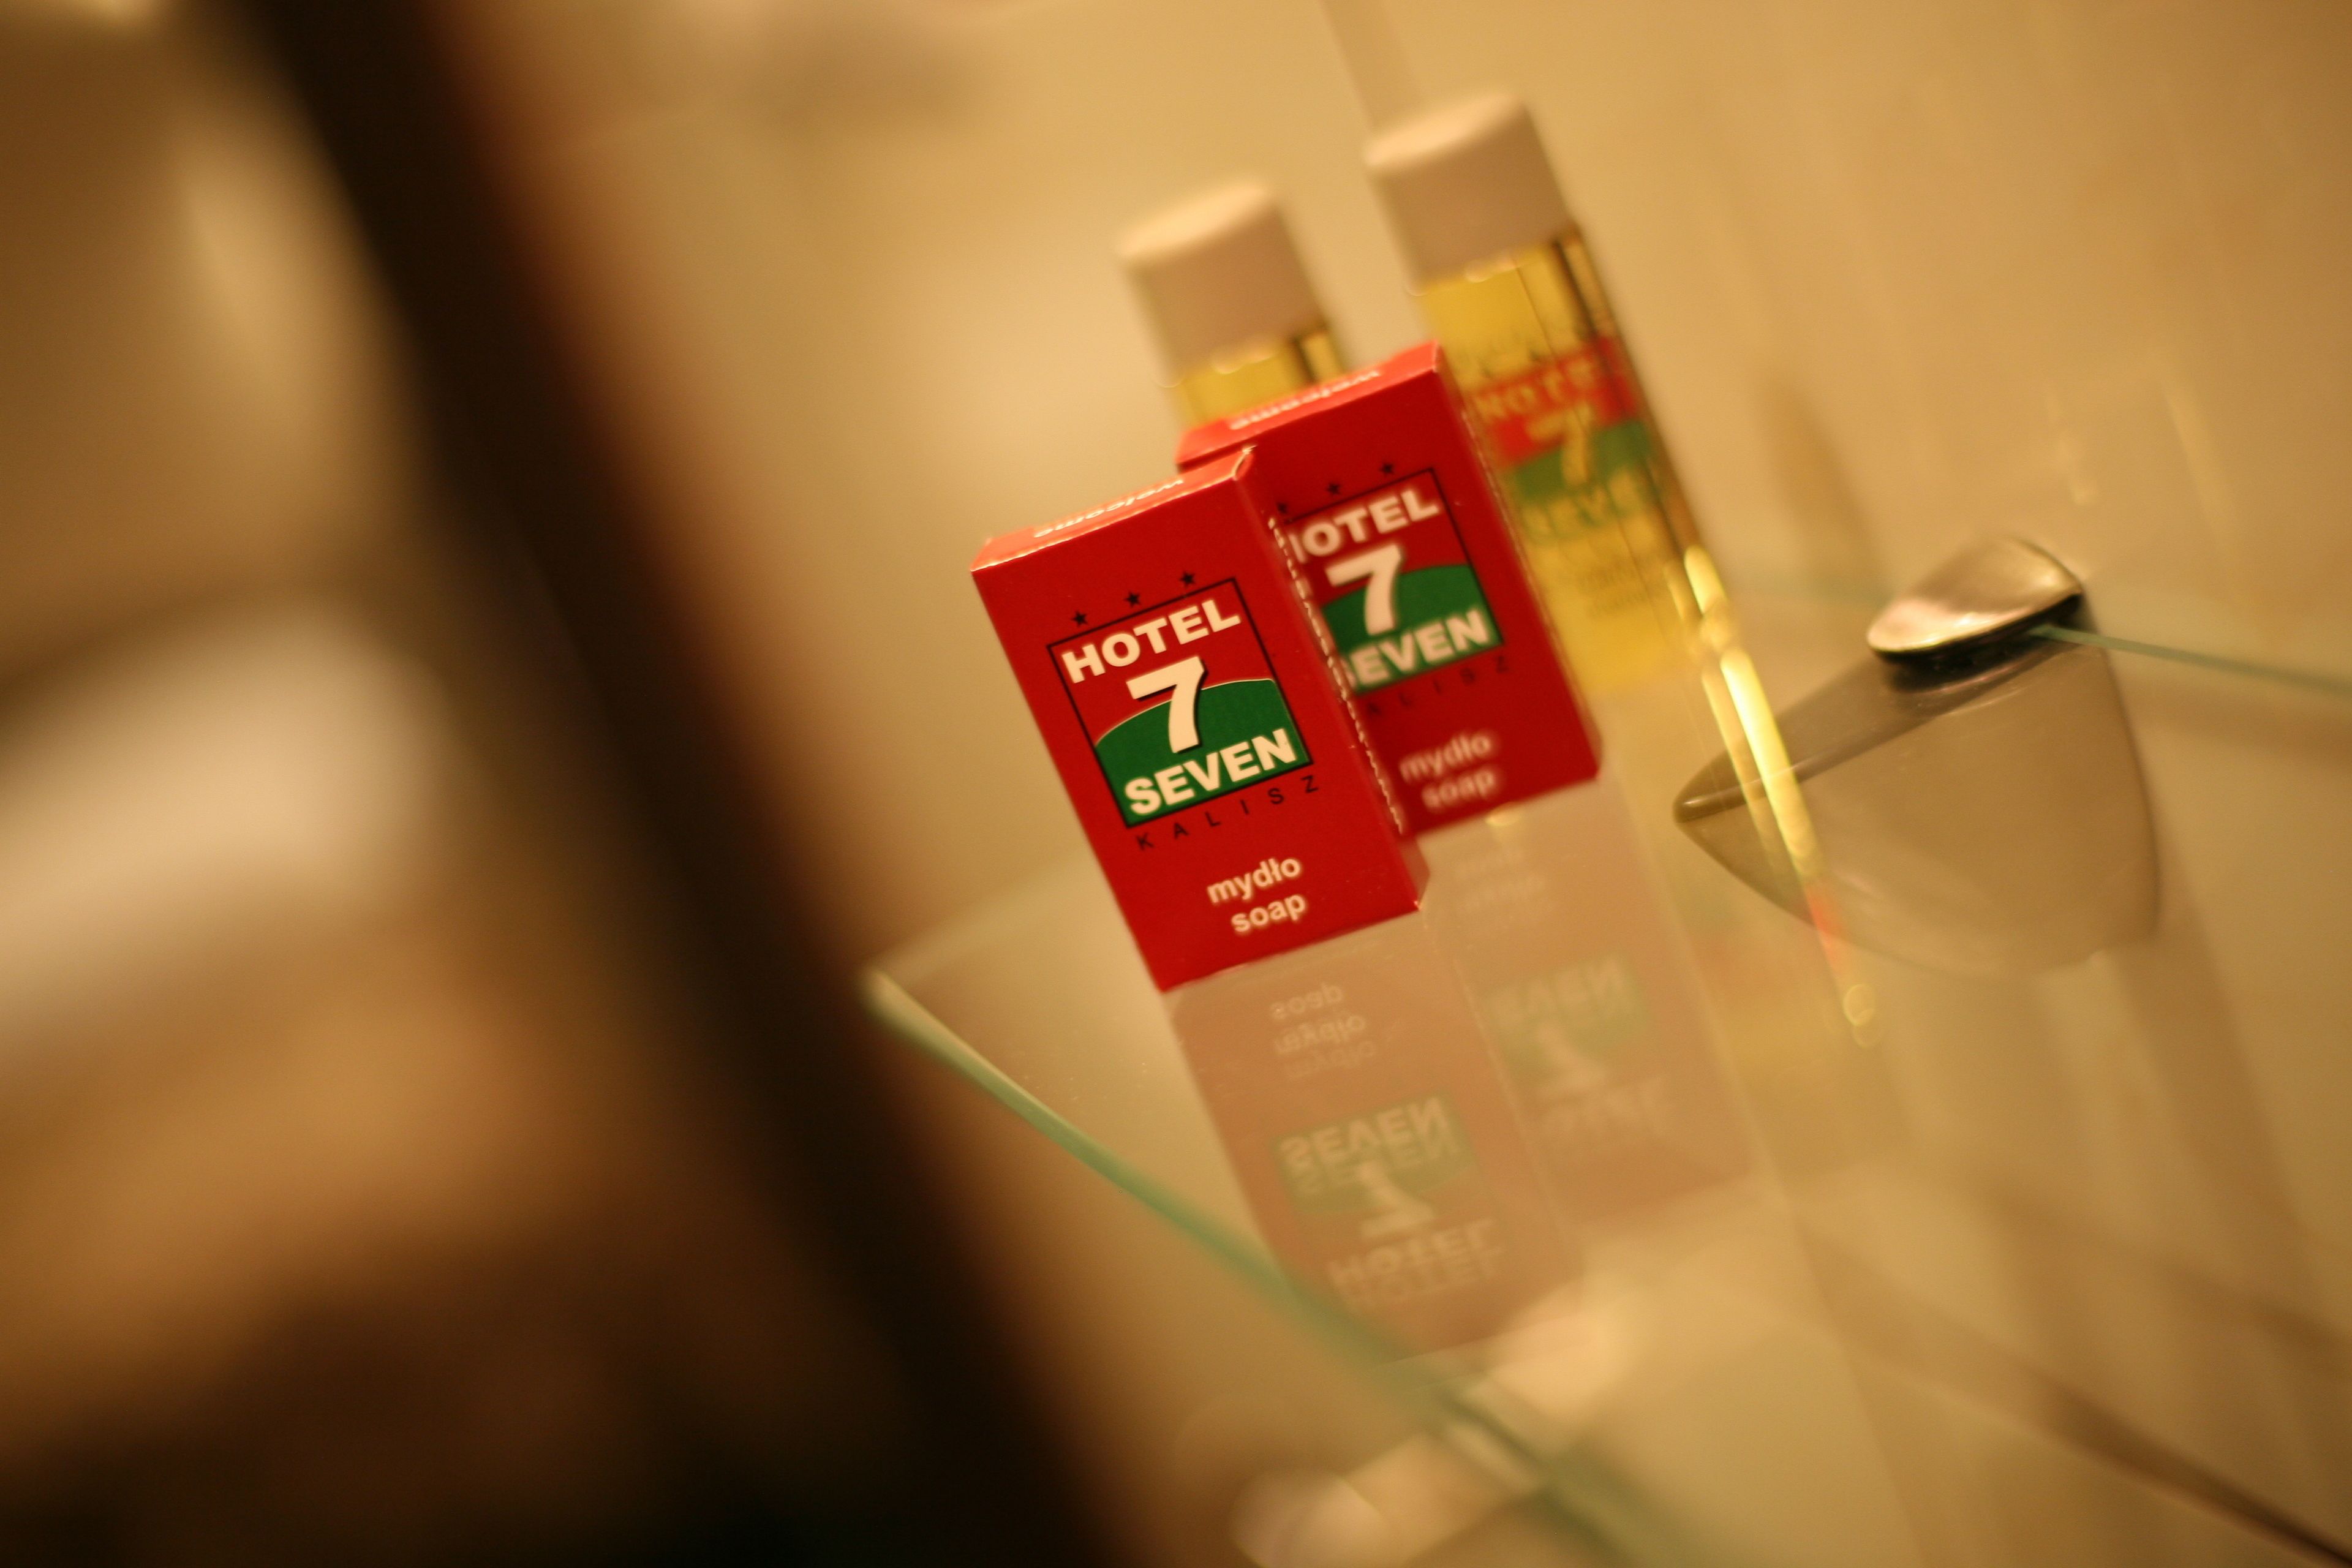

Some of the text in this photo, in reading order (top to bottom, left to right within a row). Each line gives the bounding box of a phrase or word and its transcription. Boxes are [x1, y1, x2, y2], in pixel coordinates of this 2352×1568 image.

[1526, 402, 1593, 485] 7
[1033, 480, 1183, 538] welcome
[1324, 543, 1402, 636] 7
[1062, 600, 1241, 684] HOTEL
[1126, 656, 1207, 753] 7
[1125, 728, 1297, 816] SEVEN
[1400, 731, 1493, 782] mydło
[1421, 766, 1496, 812] soap
[1136, 775, 1319, 851] KALISZ
[1207, 858, 1302, 905] mydło
[1231, 893, 1306, 933] soap
